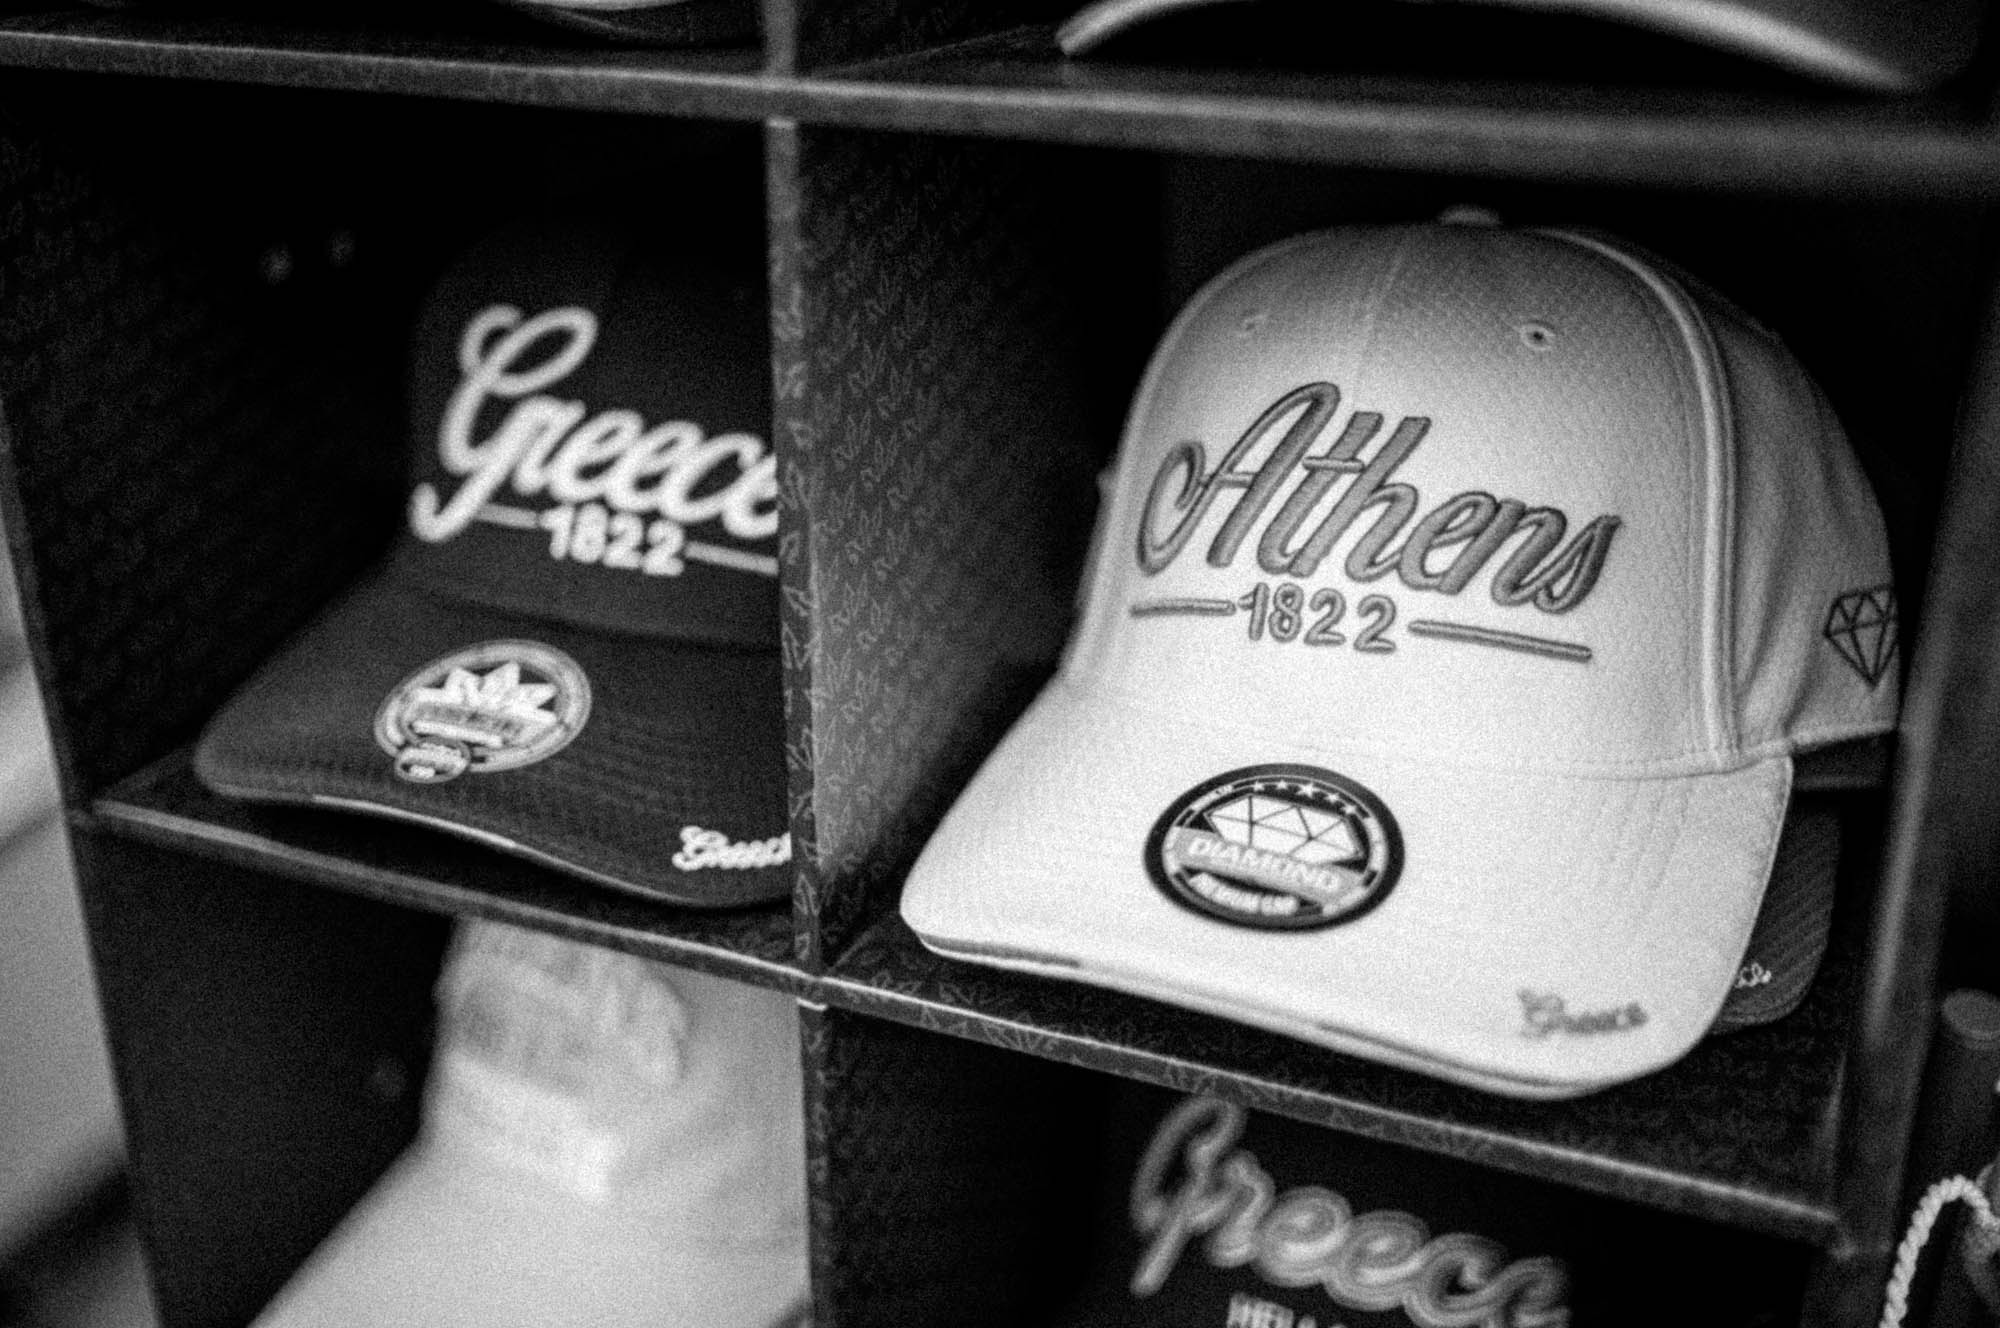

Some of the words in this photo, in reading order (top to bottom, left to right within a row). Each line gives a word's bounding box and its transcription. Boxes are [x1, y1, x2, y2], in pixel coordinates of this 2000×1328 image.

[1136, 381, 1623, 615] Athens
[538, 502, 686, 578] 1822
[1240, 582, 1397, 654] 1822
[1187, 836, 1342, 894] DIAMOND
